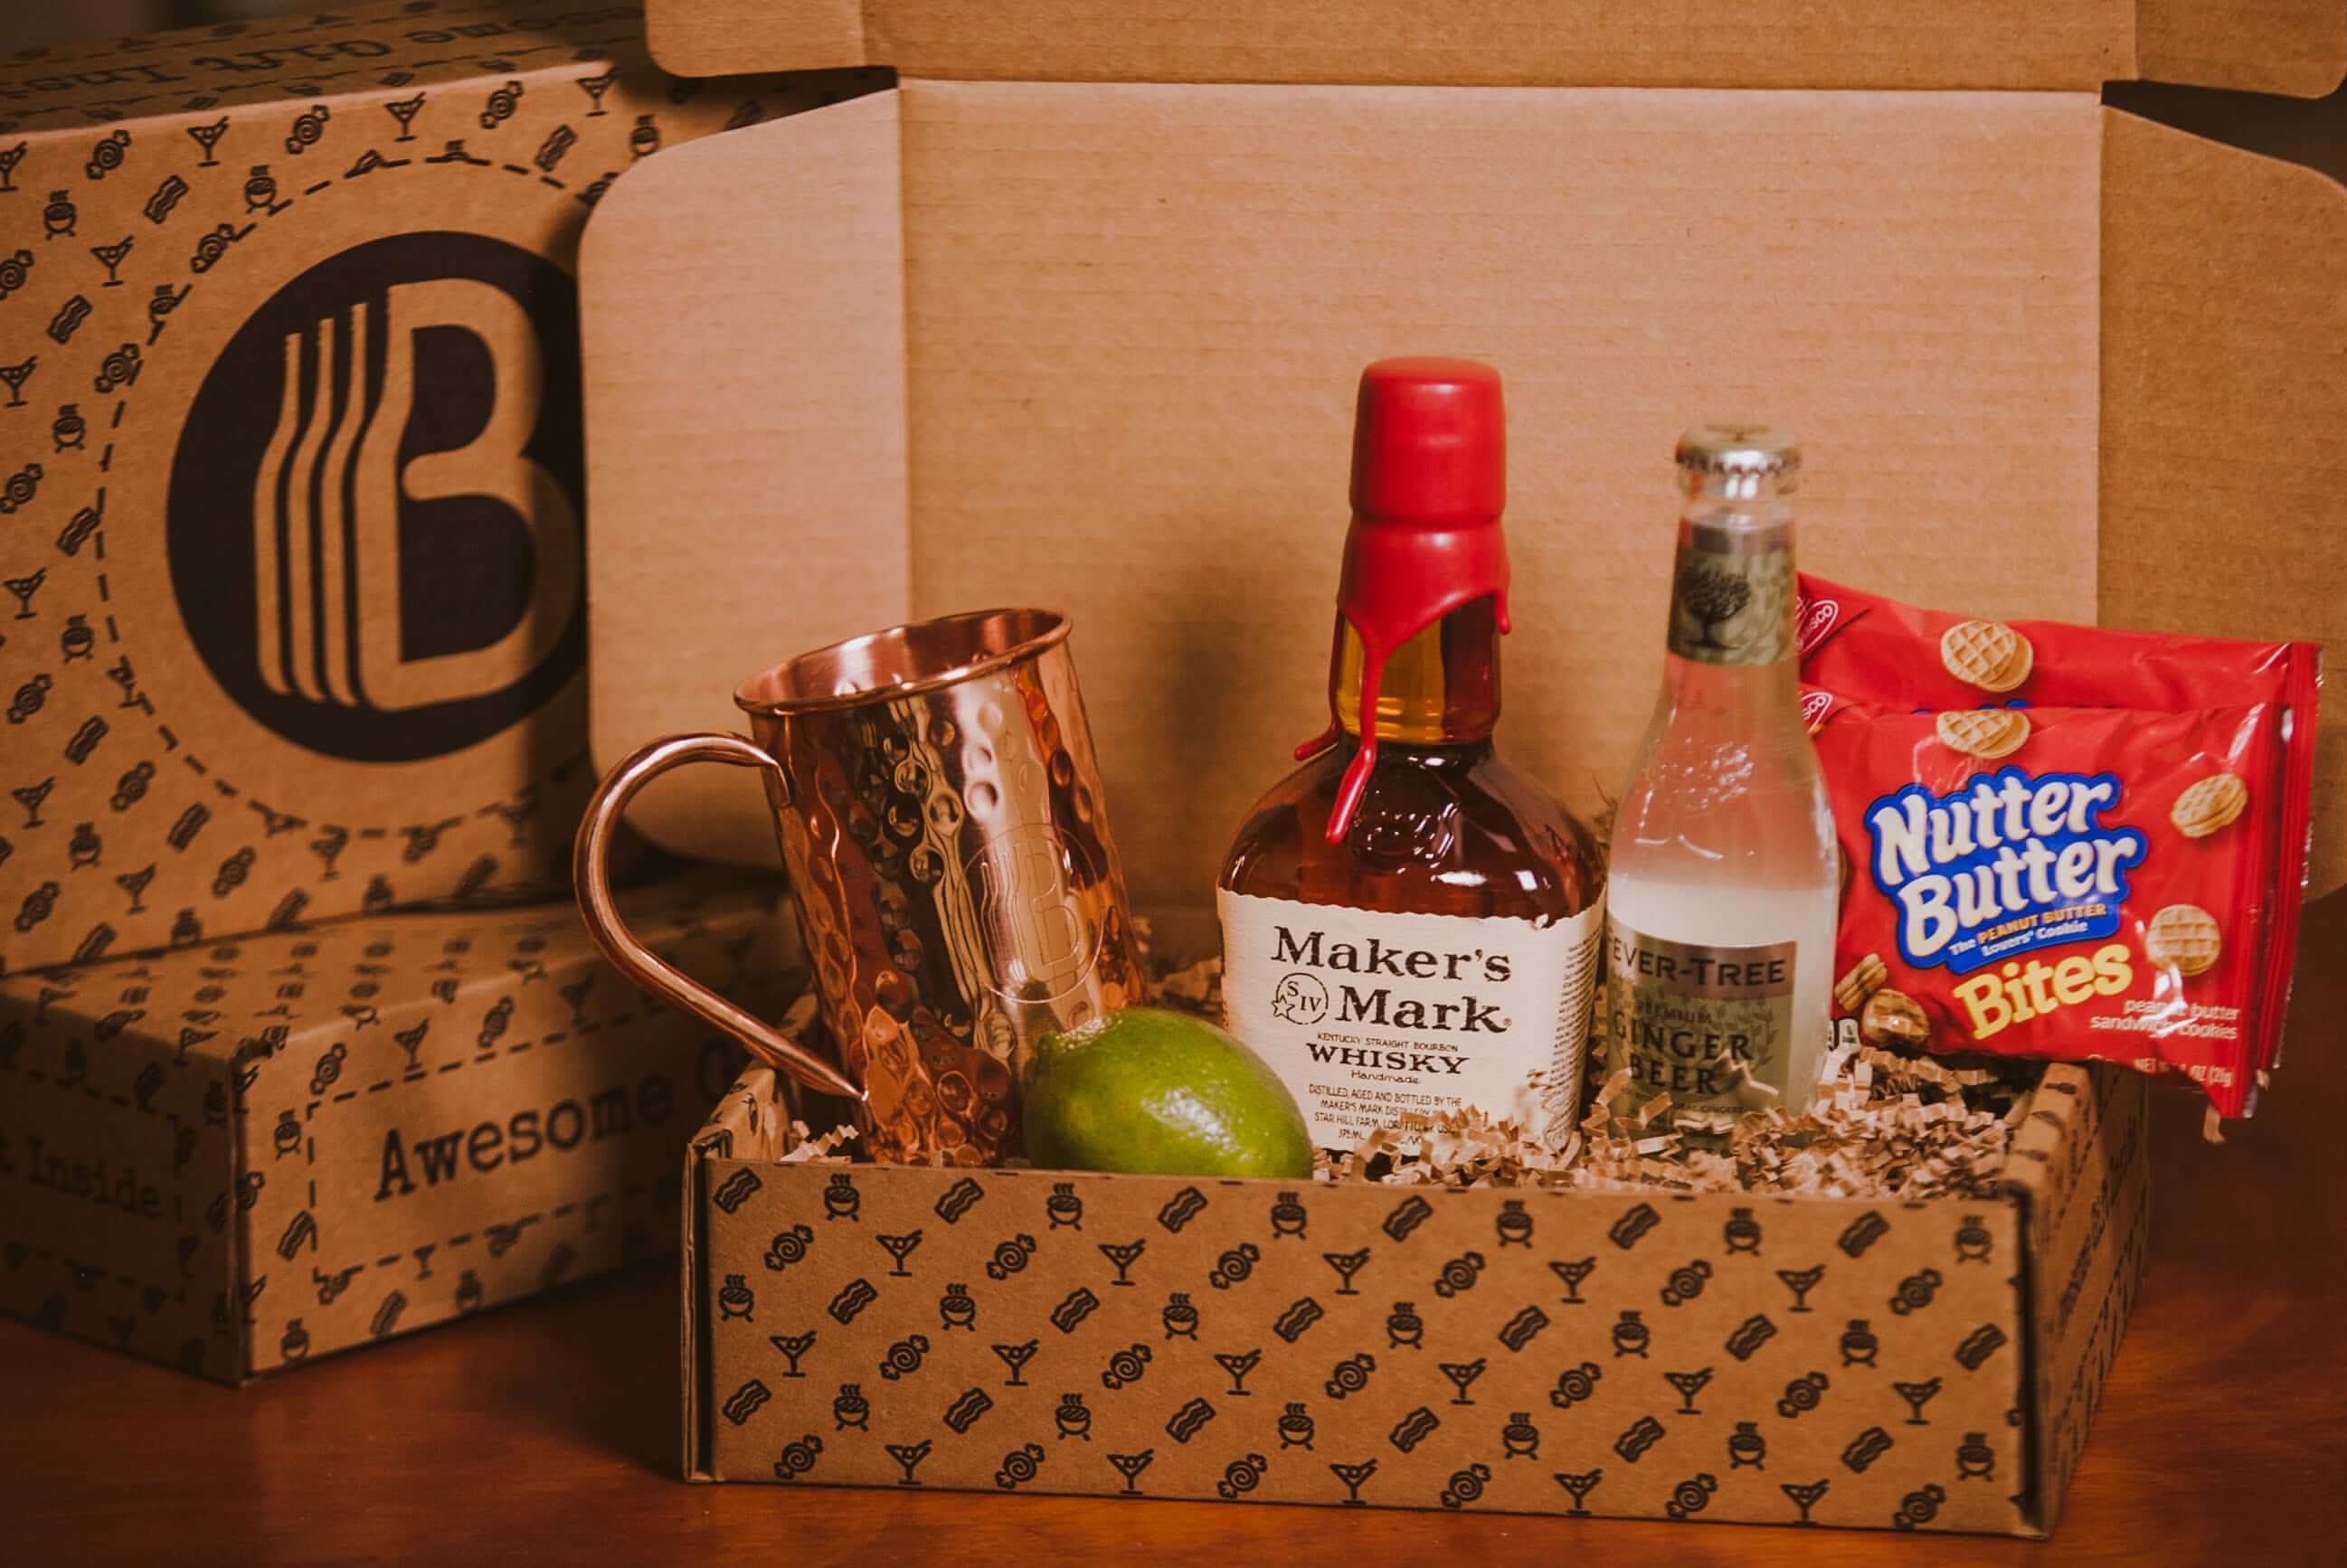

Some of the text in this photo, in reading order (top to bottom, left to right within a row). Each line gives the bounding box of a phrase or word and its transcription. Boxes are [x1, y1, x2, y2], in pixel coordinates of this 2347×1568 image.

[188, 40, 393, 72] Gift
[1872, 776, 2114, 886] Nutter
[1897, 828, 2139, 957] Butter
[1948, 903, 2107, 956] The PEANUT BUTTER
[2036, 921, 2088, 940] Cookie
[1270, 925, 1512, 983] Maker's
[1334, 985, 1509, 1034] Mark
[1953, 944, 2134, 1041] Bites
[2191, 1004, 2240, 1021] butter
[1317, 1032, 1459, 1053] KENTUCKY STRAIGHT BOURBON
[1614, 1010, 1753, 1061] GINGER
[1306, 1043, 1470, 1074] WHISKY
[1351, 1069, 1420, 1084] Handmade
[1629, 1051, 1720, 1095] BEER
[1314, 1111, 1334, 1122] STAR
[1337, 1115, 1354, 1126] HILL
[1320, 1100, 1357, 1112] MAKER'S
[1359, 1103, 1382, 1114] MARK
[1351, 1089, 1373, 1100] AGED
[1375, 1091, 1392, 1102] AND
[1394, 1092, 1431, 1105] BOTTLED
[1434, 1096, 1445, 1106] BY
[1446, 1097, 1462, 1107] THE
[374, 1073, 673, 1201] Awesome
[23, 1135, 160, 1220] Inside
